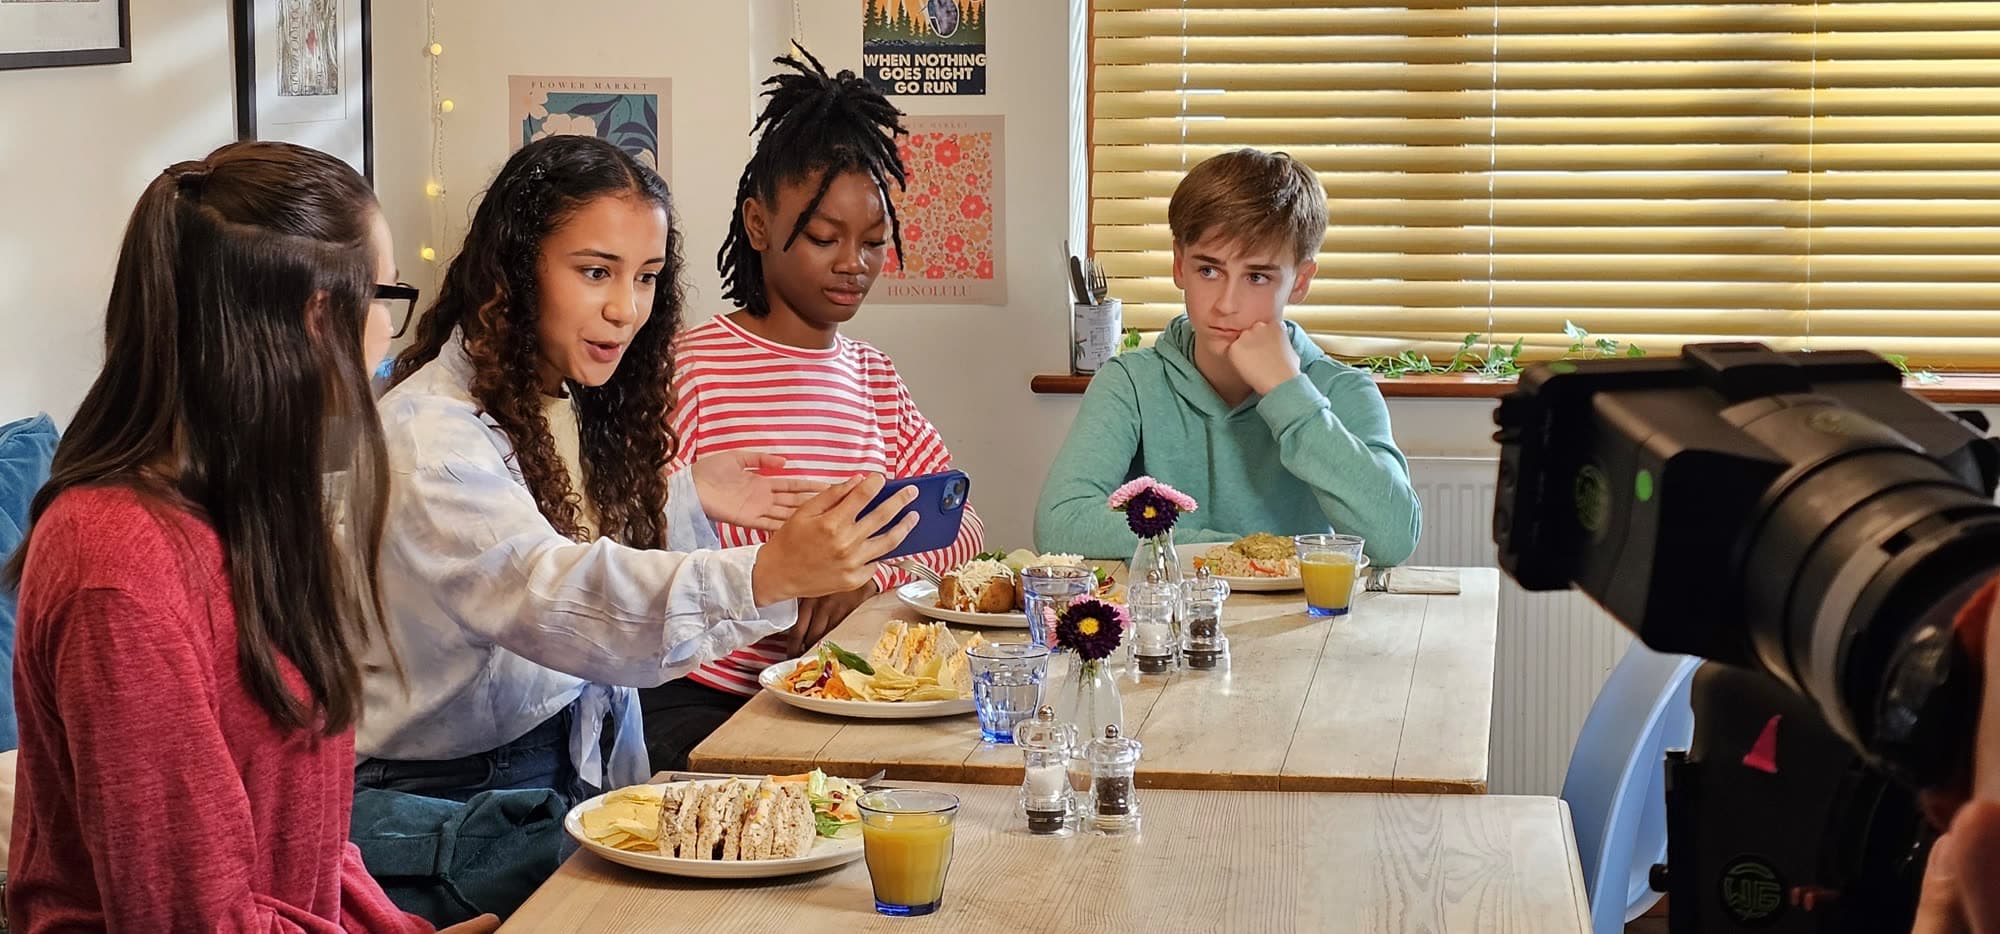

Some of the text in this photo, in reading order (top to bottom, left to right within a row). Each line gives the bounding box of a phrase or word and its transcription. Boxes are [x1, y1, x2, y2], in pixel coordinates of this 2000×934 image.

[864, 54, 986, 66] WHEN NOTHING
[879, 68, 973, 80] GOES RIGHT
[531, 81, 648, 90] FLOWER MARKET
[894, 82, 957, 93] GO RUN
[888, 286, 972, 296] HONOLULU
